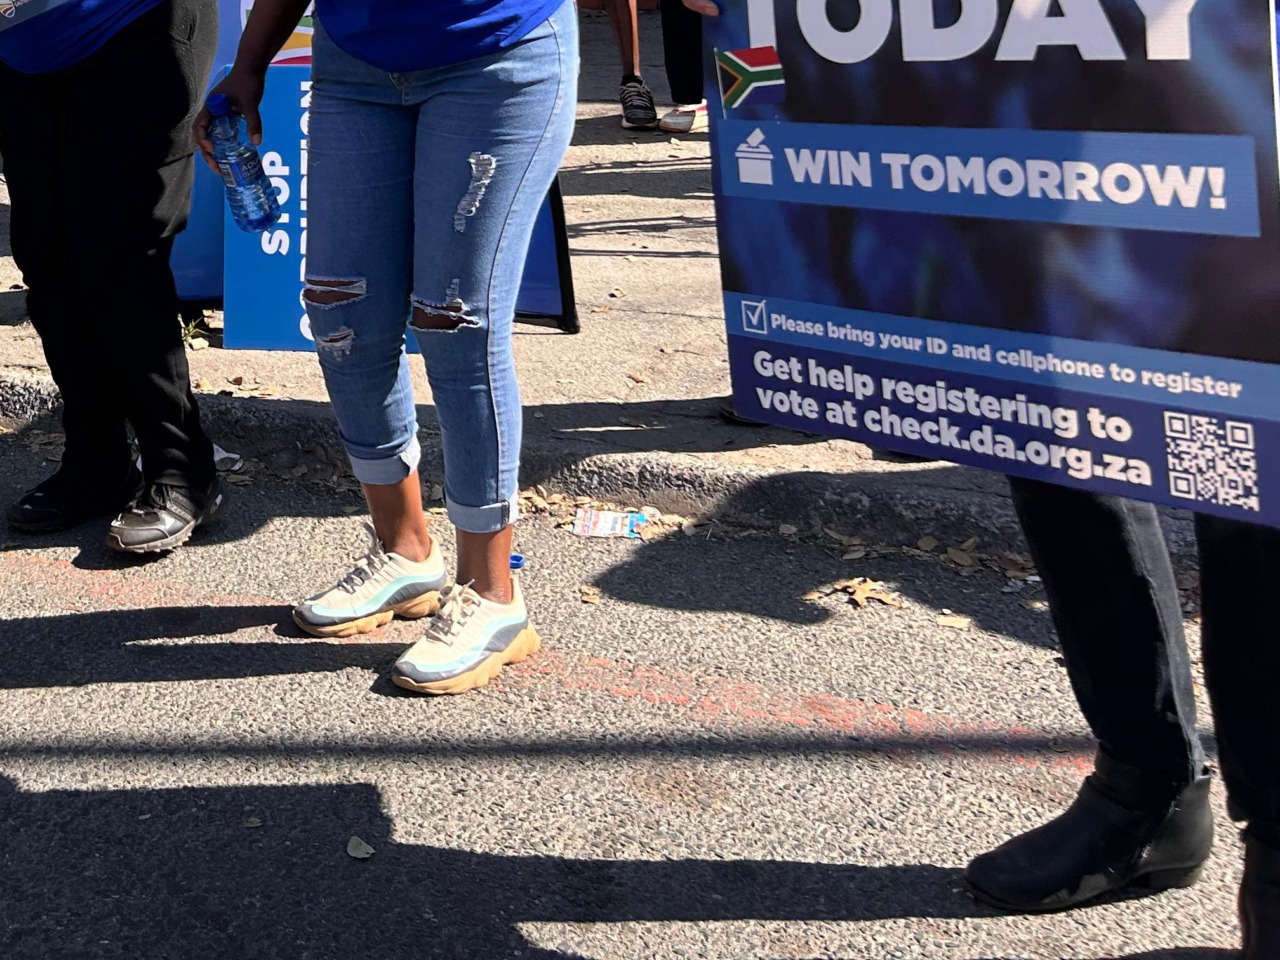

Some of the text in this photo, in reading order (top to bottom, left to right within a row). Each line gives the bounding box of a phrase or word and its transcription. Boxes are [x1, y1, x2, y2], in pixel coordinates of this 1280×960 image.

[261, 151, 290, 256] SOP
[783, 147, 1227, 210] WIN TOMORROW!
[753, 350, 1133, 442] Get help registering to
[770, 313, 1243, 399] Please bring your ID and cellphone to register
[755, 387, 1153, 486] vote at check.da.org.za
